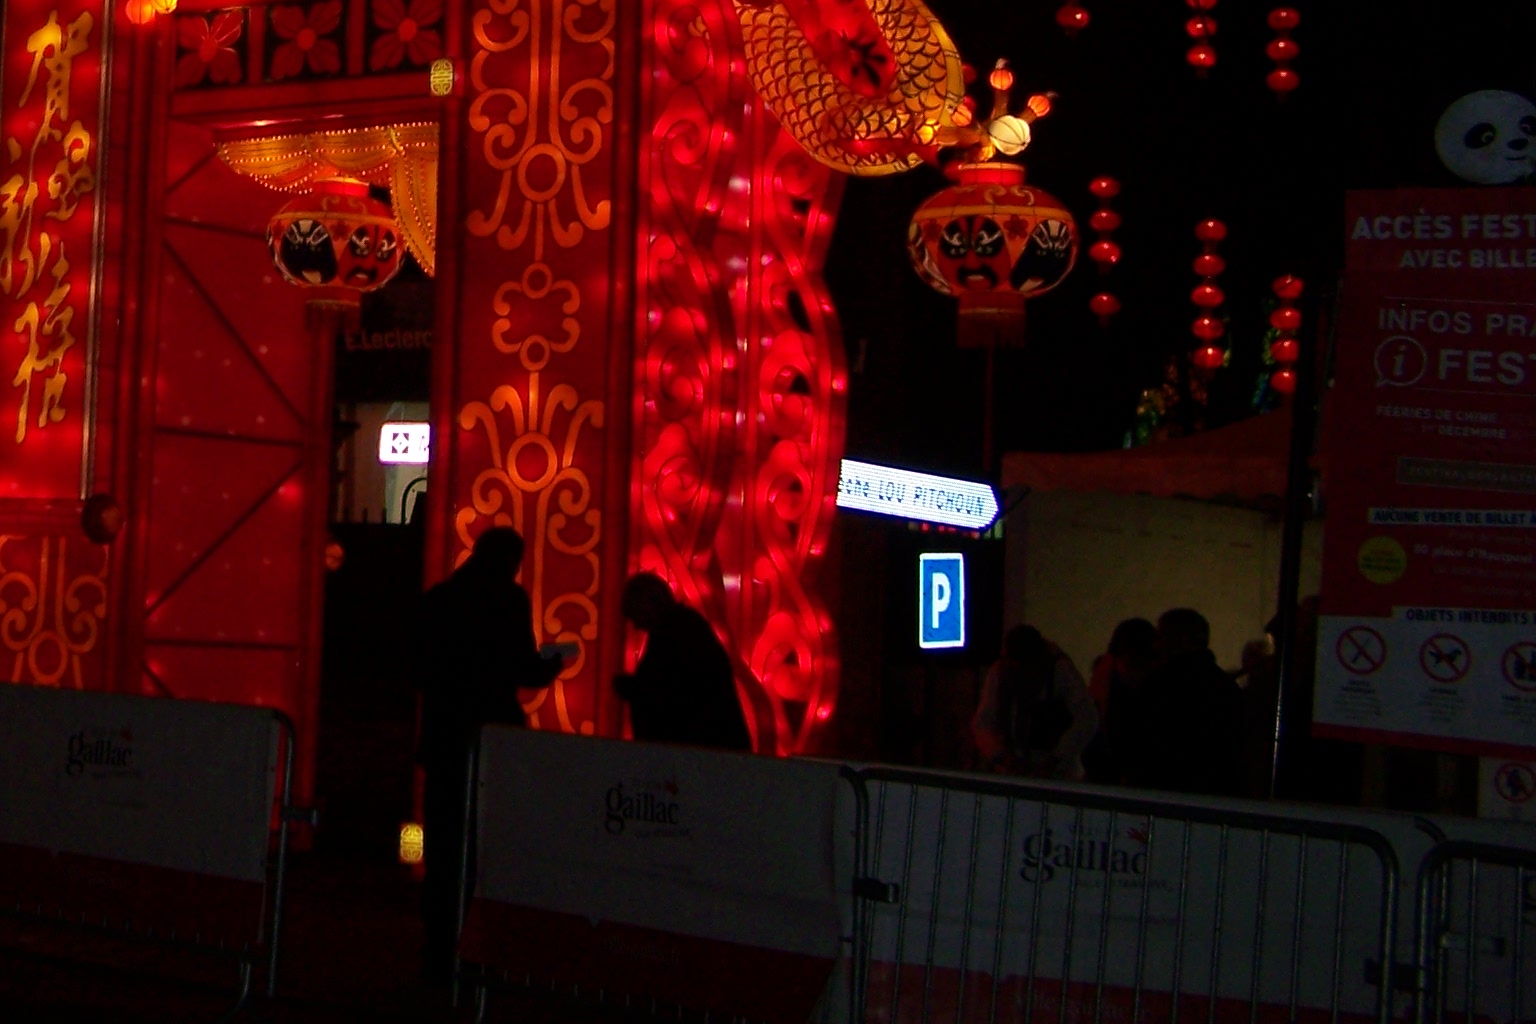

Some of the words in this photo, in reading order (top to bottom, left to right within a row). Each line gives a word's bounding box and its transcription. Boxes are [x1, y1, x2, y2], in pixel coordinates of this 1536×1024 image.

[1351, 208, 1452, 241] ACCÈS
[1399, 248, 1463, 269] AVEC
[1378, 307, 1473, 335] INFOS
[1485, 312, 1536, 338] PR
[840, 476, 870, 498] che
[878, 480, 907, 503] LOU
[1373, 510, 1419, 523] AUCUNE
[1424, 511, 1461, 524] VENTE
[1466, 512, 1482, 524] DE
[1486, 513, 1526, 525] BILLET
[932, 572, 952, 629] P
[1405, 609, 1454, 622] OBJETS
[1459, 610, 1530, 624] INTERDITS
[65, 730, 134, 775] gaillac
[605, 782, 679, 834] gaillac
[1019, 827, 1152, 883] gaillac
